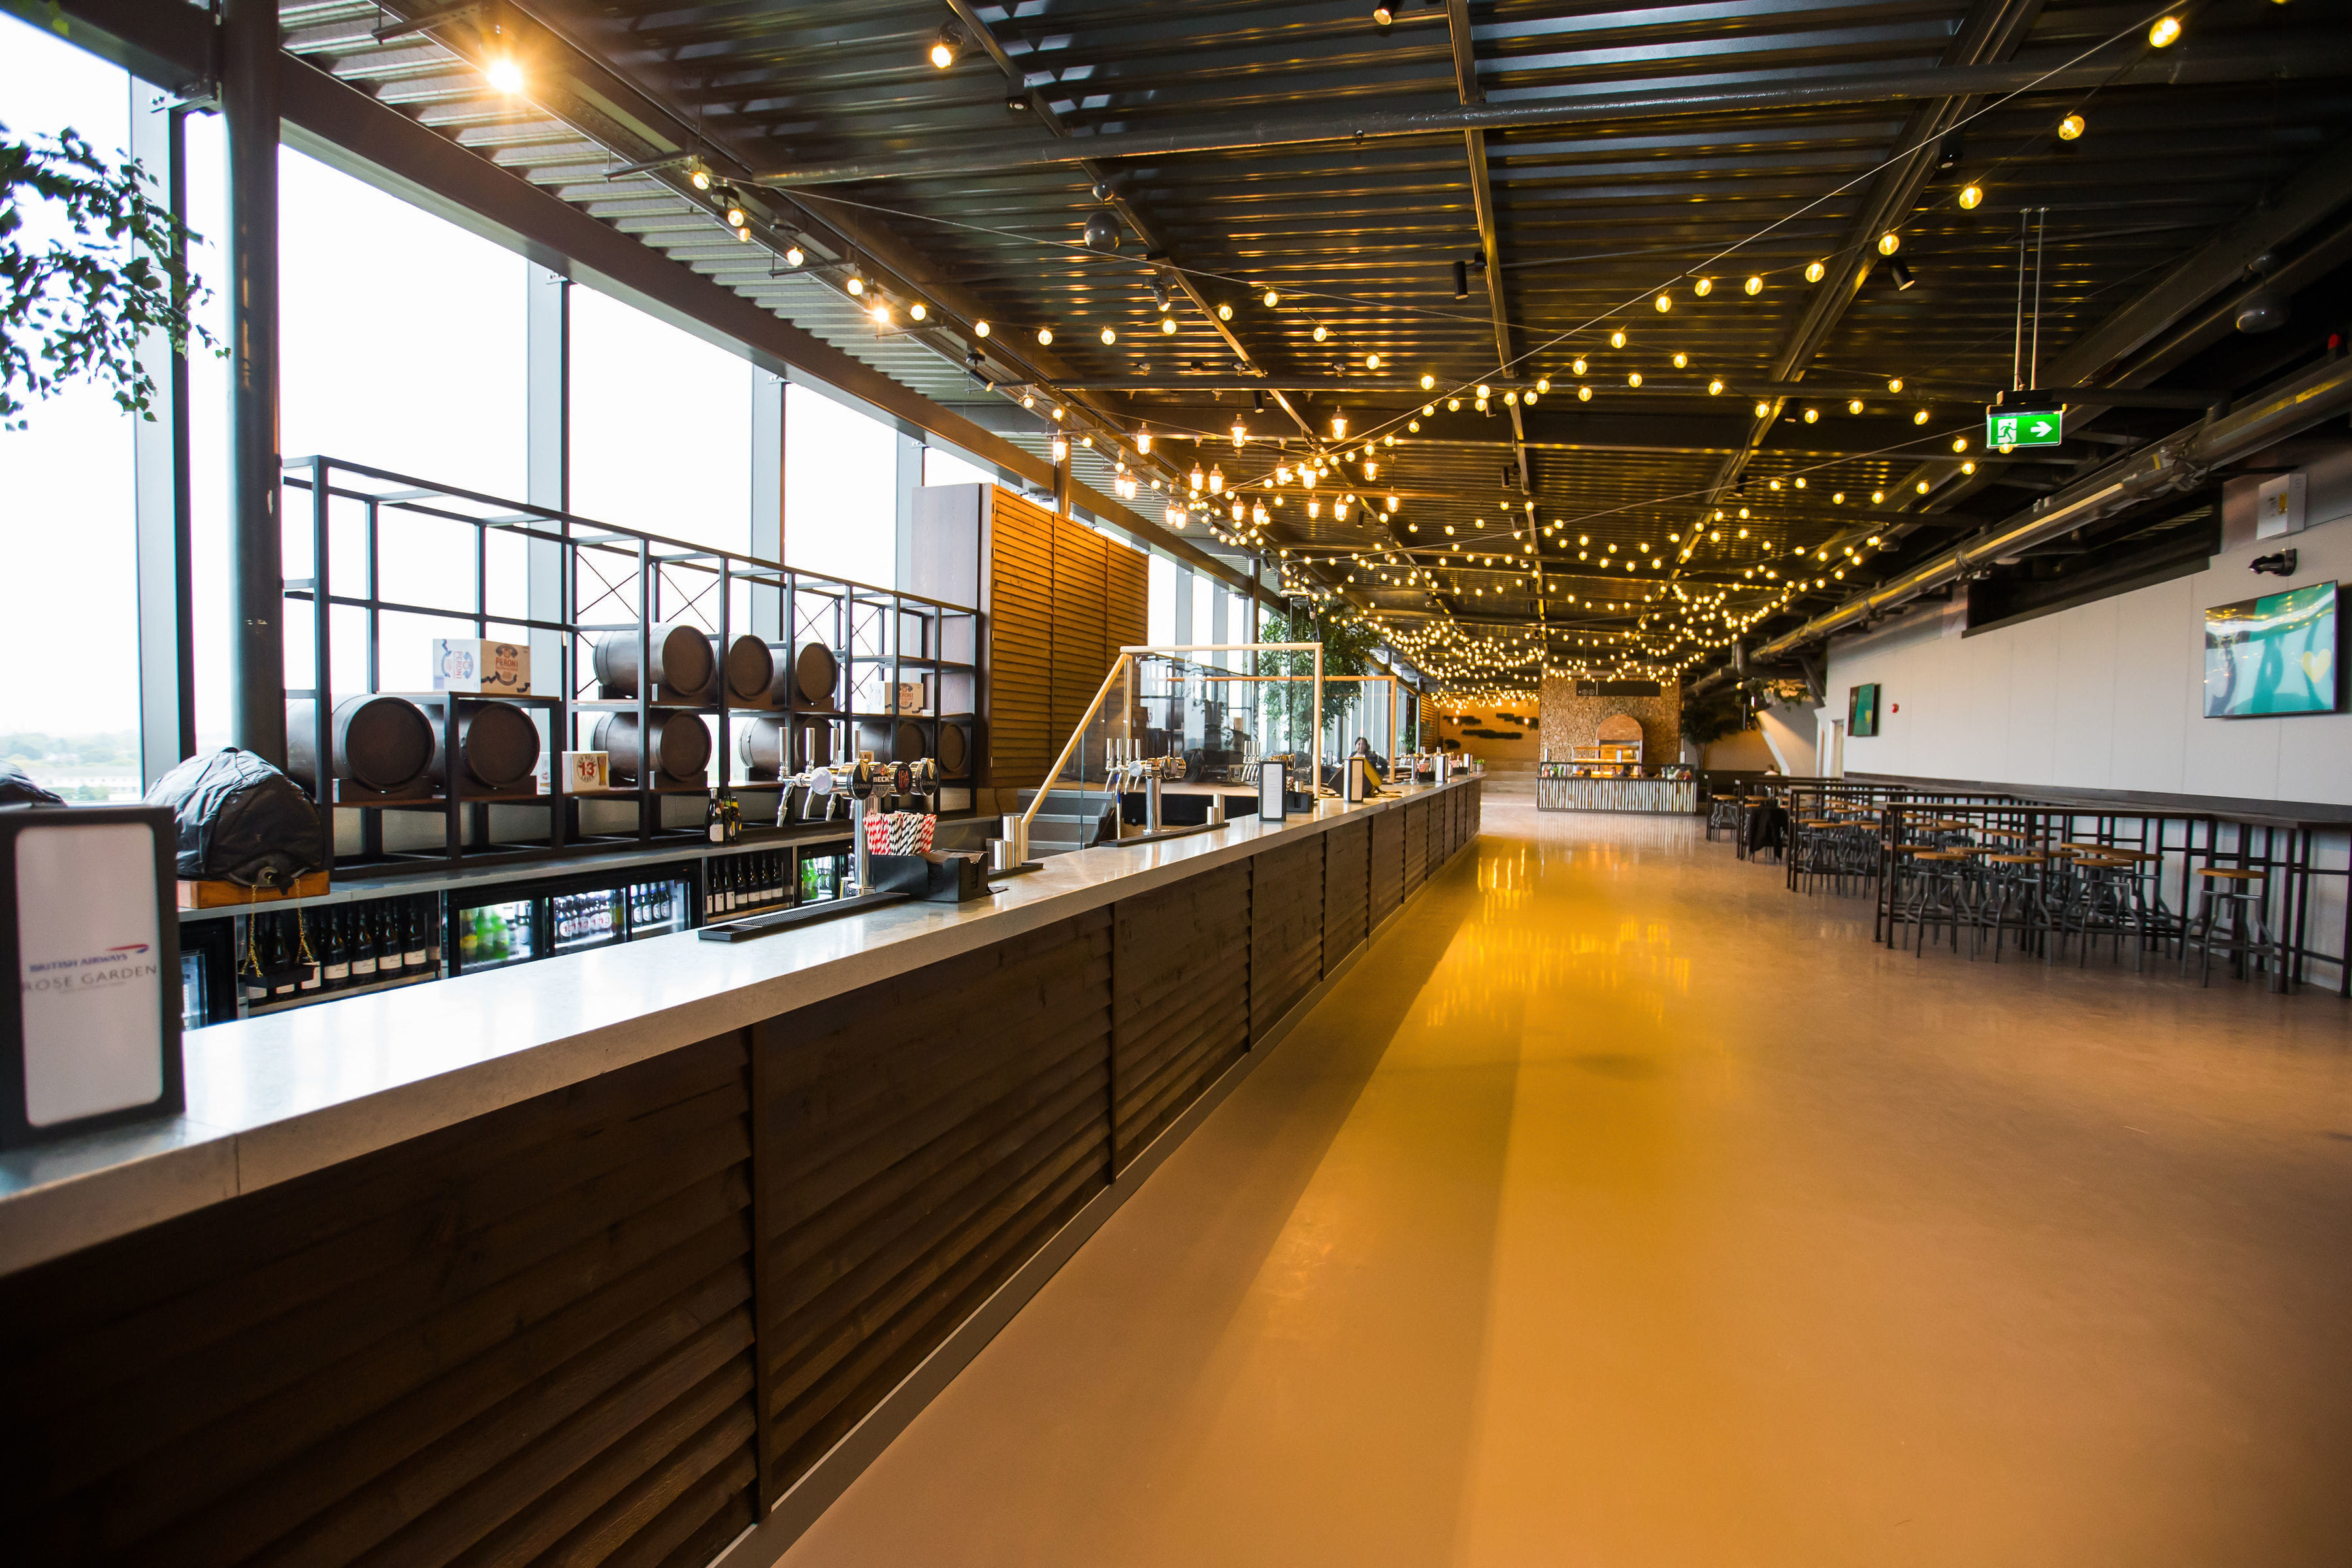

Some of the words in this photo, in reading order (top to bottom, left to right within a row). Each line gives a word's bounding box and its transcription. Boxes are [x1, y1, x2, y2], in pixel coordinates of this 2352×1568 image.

[496, 657, 518, 667] PERONI
[580, 762, 595, 776] 13
[898, 770, 909, 785] IPA
[80, 953, 128, 966] AIRWAYS
[81, 964, 157, 985] GARDEN
